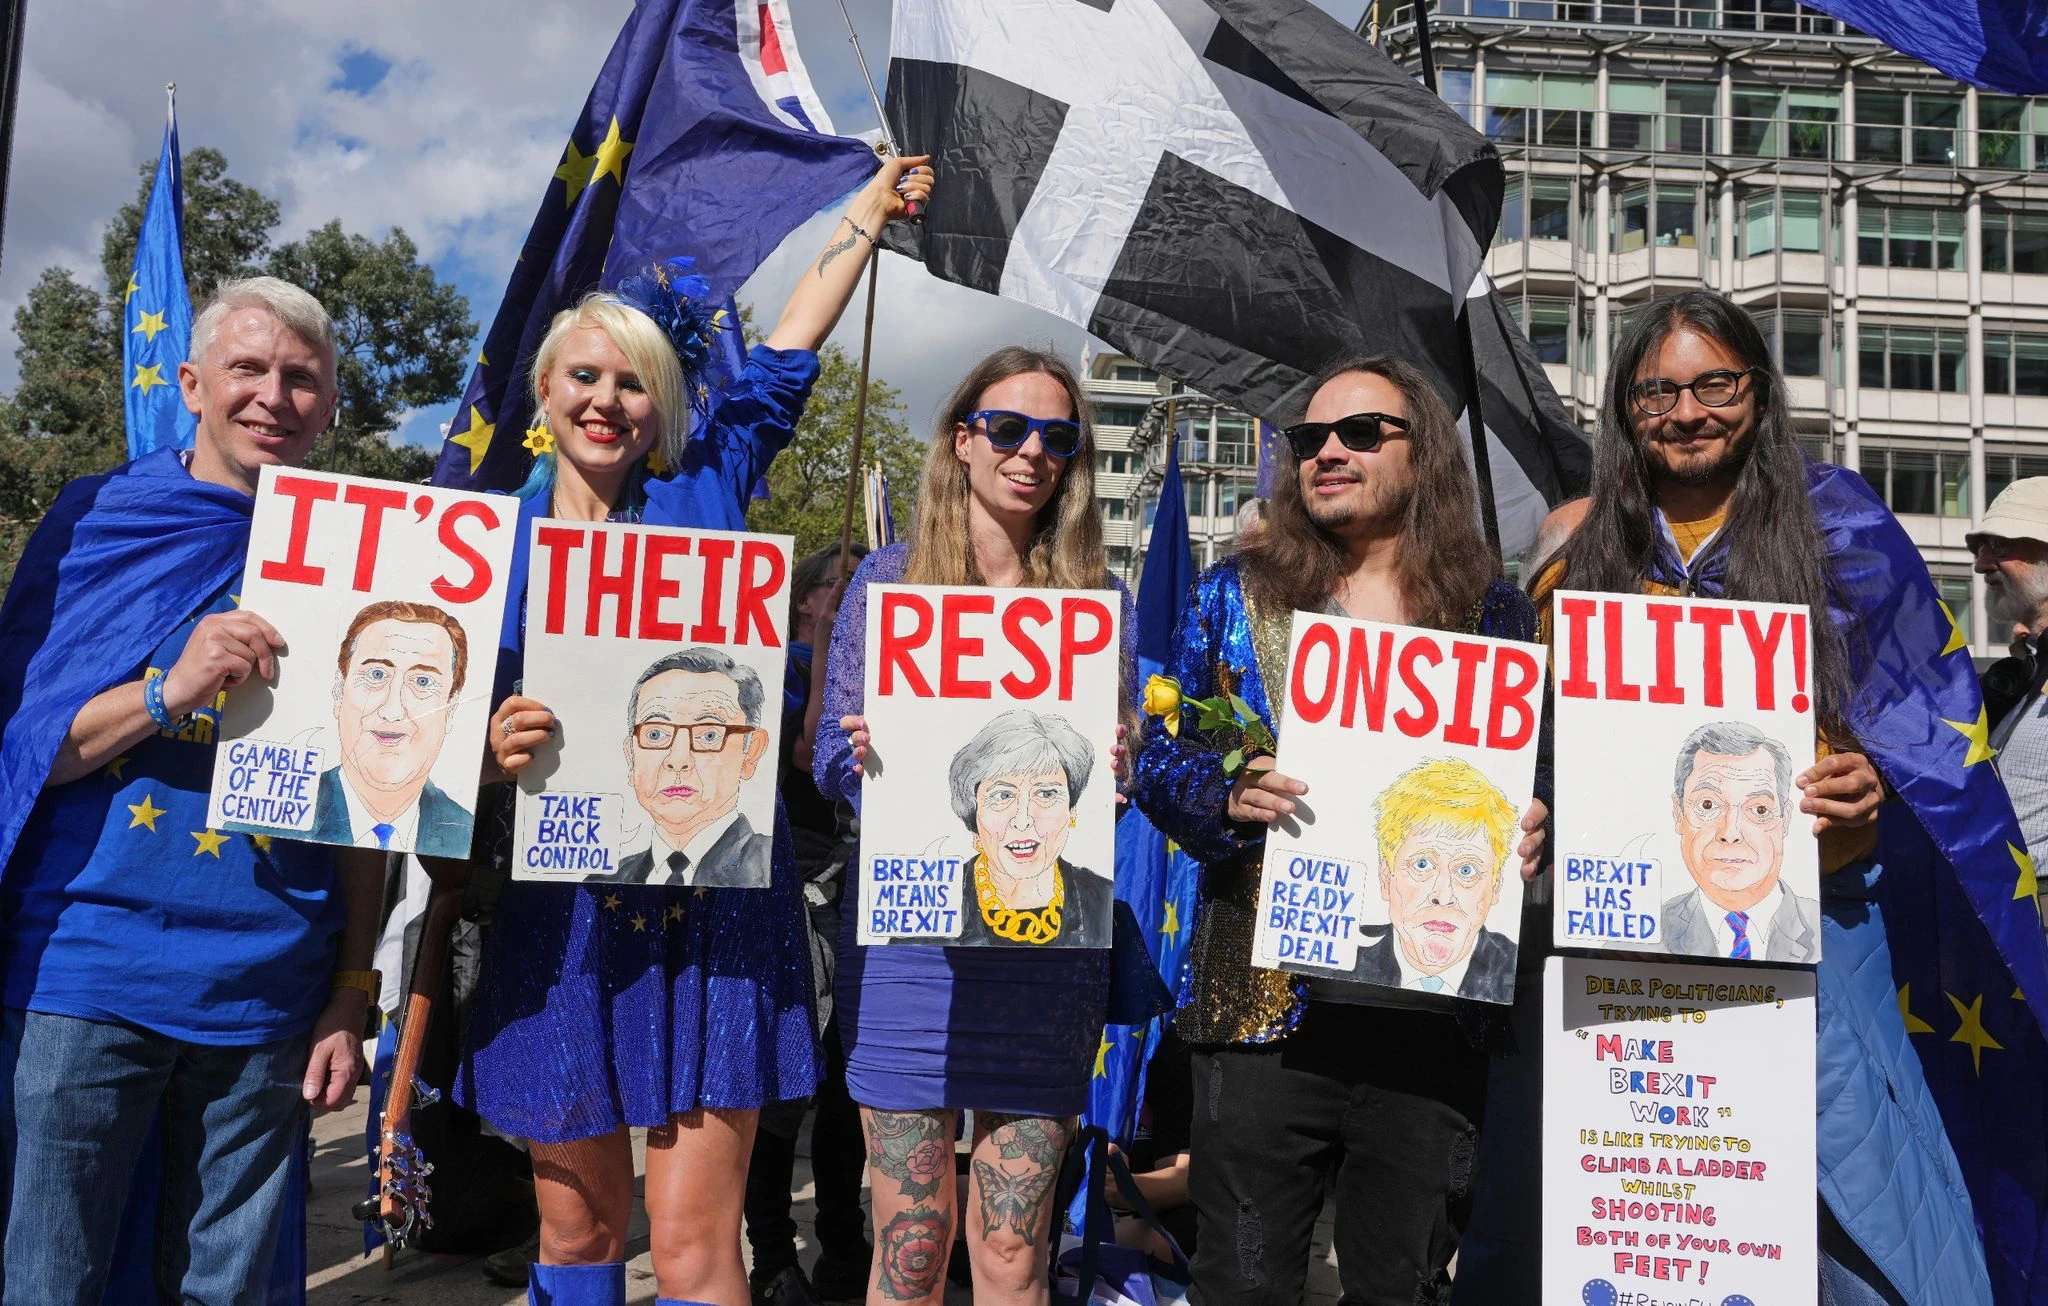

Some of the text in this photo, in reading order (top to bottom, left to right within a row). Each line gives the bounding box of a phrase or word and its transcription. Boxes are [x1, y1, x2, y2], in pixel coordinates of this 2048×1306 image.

[260, 474, 502, 604] IT'S
[537, 526, 786, 647] THEIR
[877, 592, 1113, 700] RESP
[1561, 597, 1810, 713] ILITY!
[1290, 622, 1540, 750] ONSIB
[229, 742, 318, 776] GAMBLE
[229, 766, 310, 801] OF THE
[222, 793, 311, 826] CENTURY
[538, 795, 602, 820] TAKE
[537, 819, 601, 845] BACK
[526, 845, 614, 871] CONTROL
[873, 858, 960, 882] BREXIT
[1288, 857, 1350, 887] OVEN
[1566, 858, 1652, 886] BREXIT
[875, 884, 950, 908] MEANS
[1272, 879, 1355, 913] READY
[1585, 886, 1632, 911] HAS
[871, 908, 957, 933] BREXIT
[1269, 905, 1356, 939] BREXIT
[1567, 910, 1656, 939] FAILED
[1278, 933, 1339, 965] DEAL
[1586, 975, 1784, 1009] DEAR POLITICIANS,
[1598, 1004, 1707, 1024] TRYING TO
[1609, 1067, 1717, 1099] BREXIT
[1580, 1129, 1752, 1152] IS LIKE TRYING TO
[1580, 1154, 1767, 1181] CLIMB A LADDER
[1621, 1178, 1697, 1201] WHILST
[1591, 1196, 1716, 1227] SHOOTING
[1576, 1226, 1782, 1260] BOTH OF YOUR OWN
